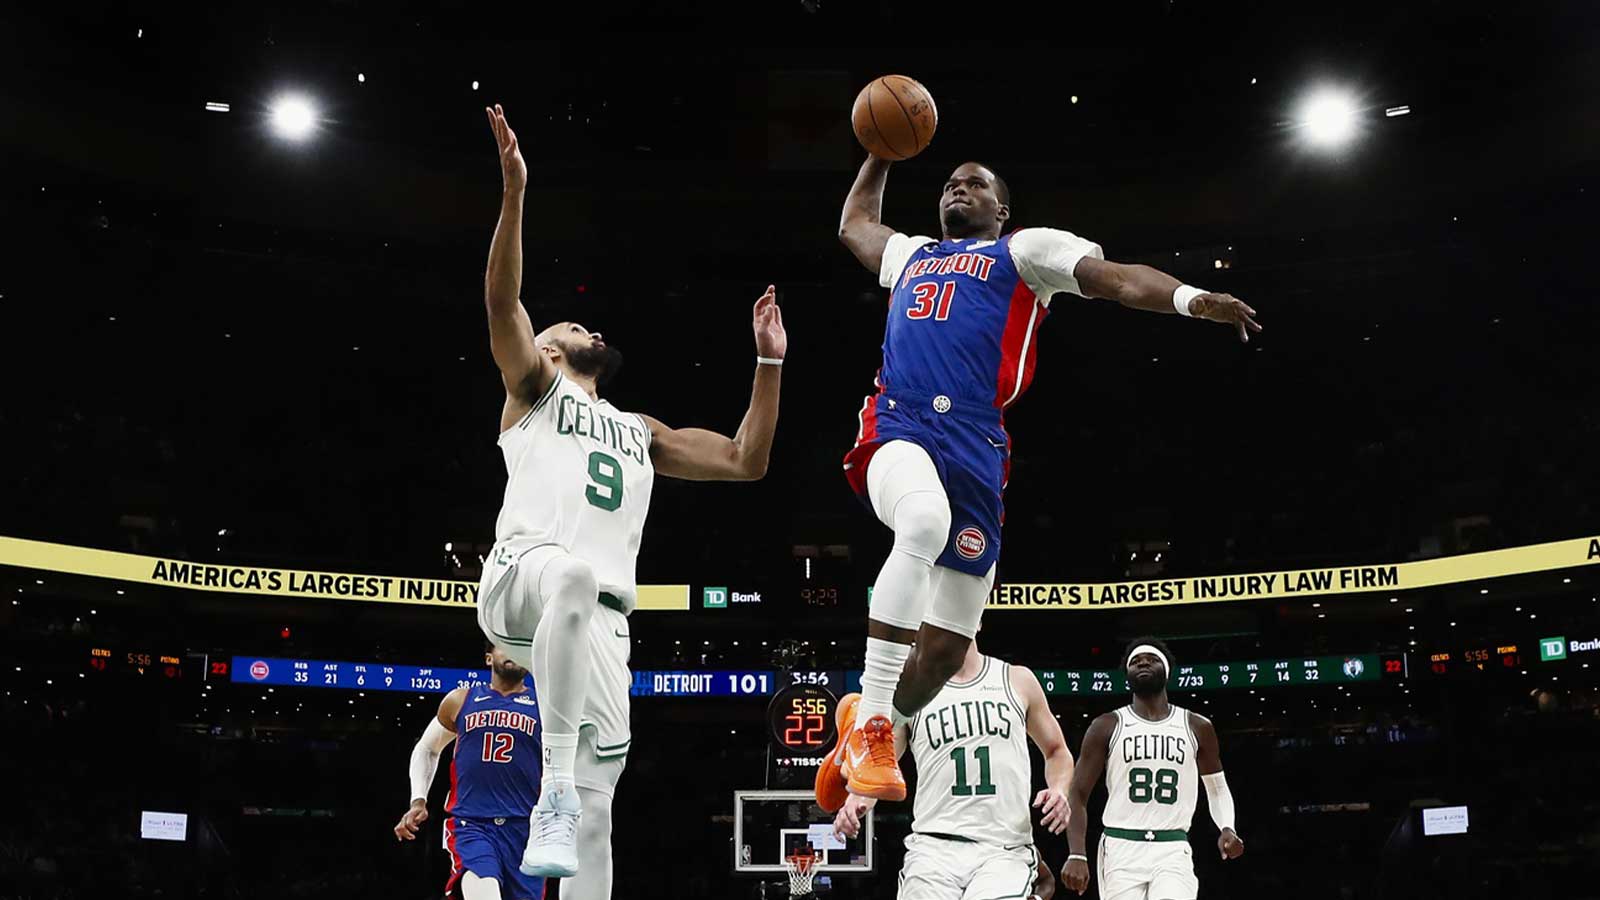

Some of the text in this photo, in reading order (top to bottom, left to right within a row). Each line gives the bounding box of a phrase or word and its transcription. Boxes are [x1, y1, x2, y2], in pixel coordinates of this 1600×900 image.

[901, 253, 996, 288] DETROIT
[907, 281, 955, 321] 31
[557, 395, 644, 466] CELTICS
[585, 451, 623, 512] 9
[152, 560, 282, 591] AMERICA'S
[289, 572, 393, 598] LARGEST
[989, 567, 1398, 605] ERICA'S LARGEST INJURY LAW FIRM
[706, 591, 761, 604] TD Bank
[127, 653, 151, 666] 5:56
[1465, 650, 1489, 662] 5:56
[1542, 638, 1600, 657] TD Bank
[211, 661, 228, 674] 22
[791, 671, 829, 686] 5:56
[1385, 660, 1401, 672] 22
[294, 672, 308, 682] 35
[325, 673, 337, 684] 21
[357, 675, 365, 685] 6
[385, 676, 393, 687] 9
[410, 677, 441, 690] 13/33
[653, 674, 713, 693] DETROIT
[729, 674, 767, 693] 101
[1046, 670, 1319, 691] 0 2 47.2 7/33 9 7 14 32
[792, 698, 827, 715] 5:56
[465, 709, 537, 736] DETROIT
[785, 715, 824, 745] 22
[925, 701, 1011, 750] CELTICS
[482, 732, 514, 763] 12
[1123, 735, 1186, 765] CELTICS
[791, 757, 824, 767] TISSO
[950, 746, 996, 796] 11
[1129, 767, 1179, 805] 88
